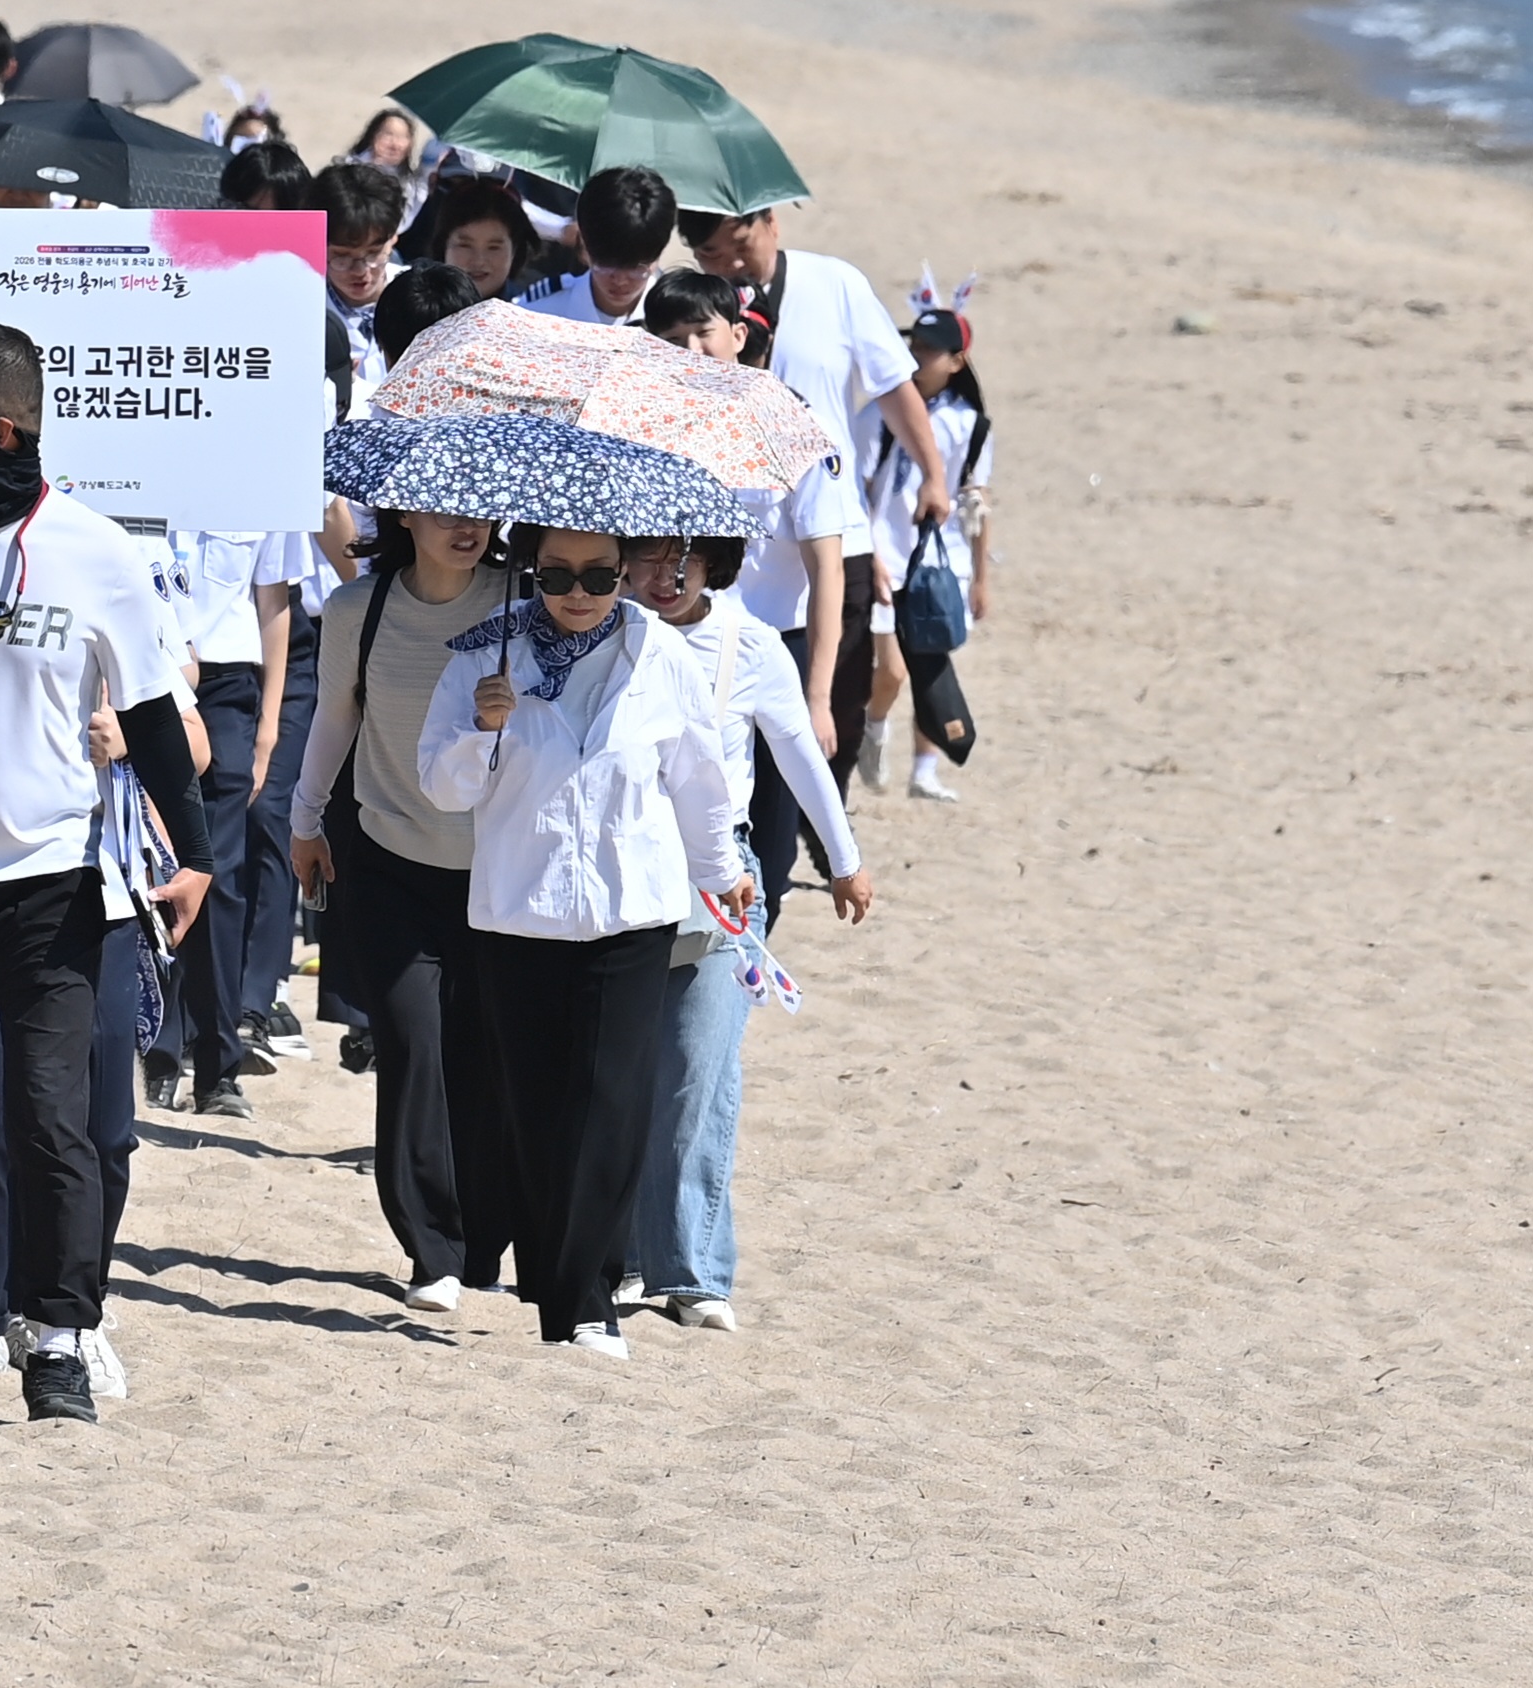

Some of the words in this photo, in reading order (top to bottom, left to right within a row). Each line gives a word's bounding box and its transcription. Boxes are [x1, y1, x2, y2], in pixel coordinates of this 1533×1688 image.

[14, 257, 34, 265] 2026
[33, 272, 74, 295] 영웅의
[77, 271, 116, 296] 용기에
[120, 275, 159, 291] 피어난
[161, 272, 191, 299] 오늘
[84, 345, 175, 379] 고귀한
[182, 346, 272, 380] 희생을
[53, 386, 212, 420] 않겠습니다.
[78, 480, 142, 491] 경상북도교육청
